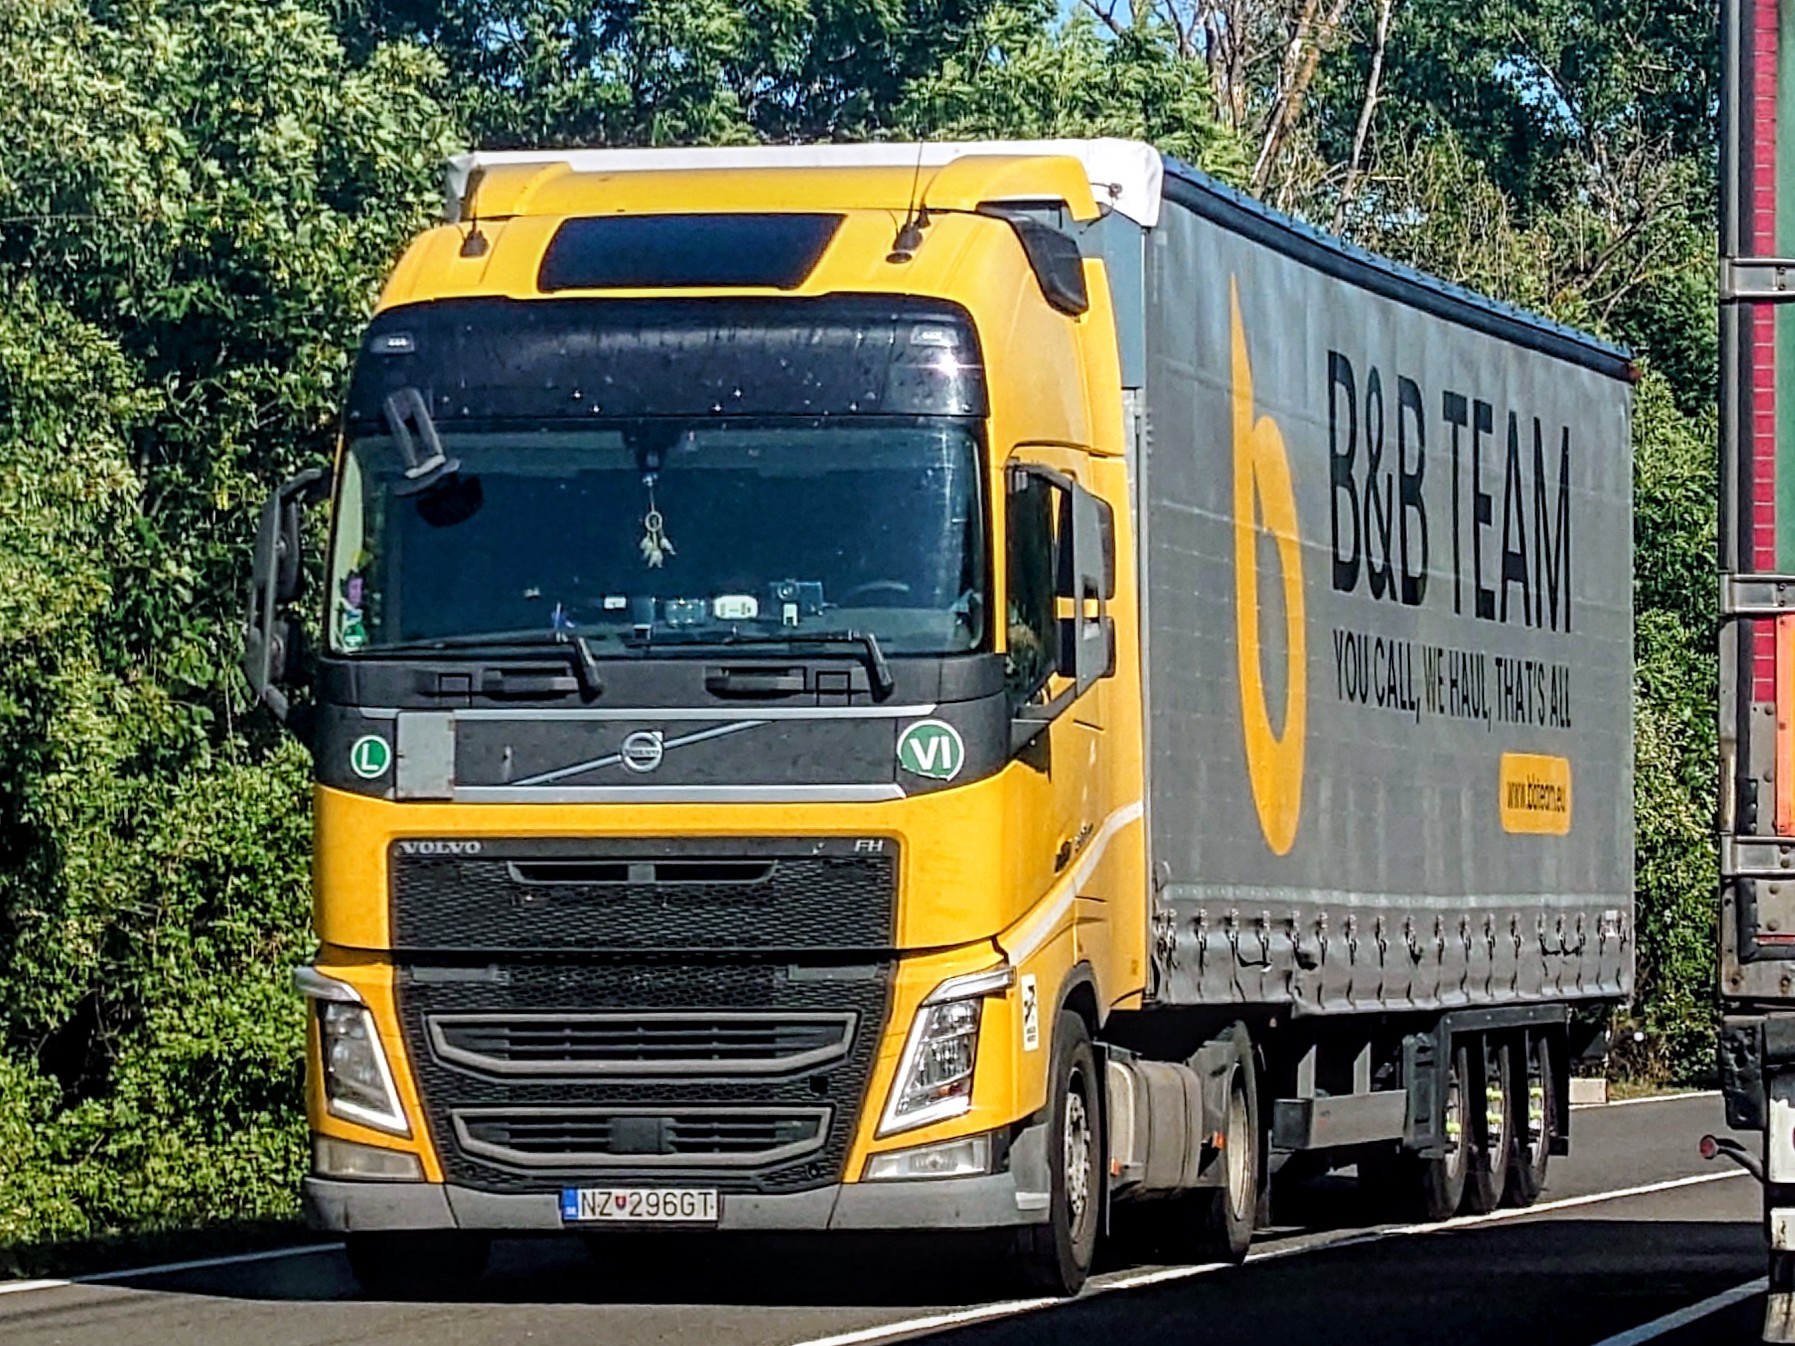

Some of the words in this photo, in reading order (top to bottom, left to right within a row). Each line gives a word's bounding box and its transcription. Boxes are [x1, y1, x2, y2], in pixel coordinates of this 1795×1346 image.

[1328, 349, 1428, 606] B&B
[1442, 389, 1571, 633] TEAM
[1333, 629, 1369, 704] YOU
[1374, 636, 1420, 724] CALL,
[1423, 645, 1444, 715] WE
[1449, 650, 1491, 733] HAUL,
[1495, 656, 1546, 726] THAT'S
[1550, 664, 1571, 728] ALL
[361, 743, 379, 771] L
[909, 736, 951, 770] VI
[399, 841, 481, 854] VOLVO
[854, 839, 883, 852] FH
[581, 1191, 612, 1217] NZ
[628, 1192, 713, 1217] 296GT
